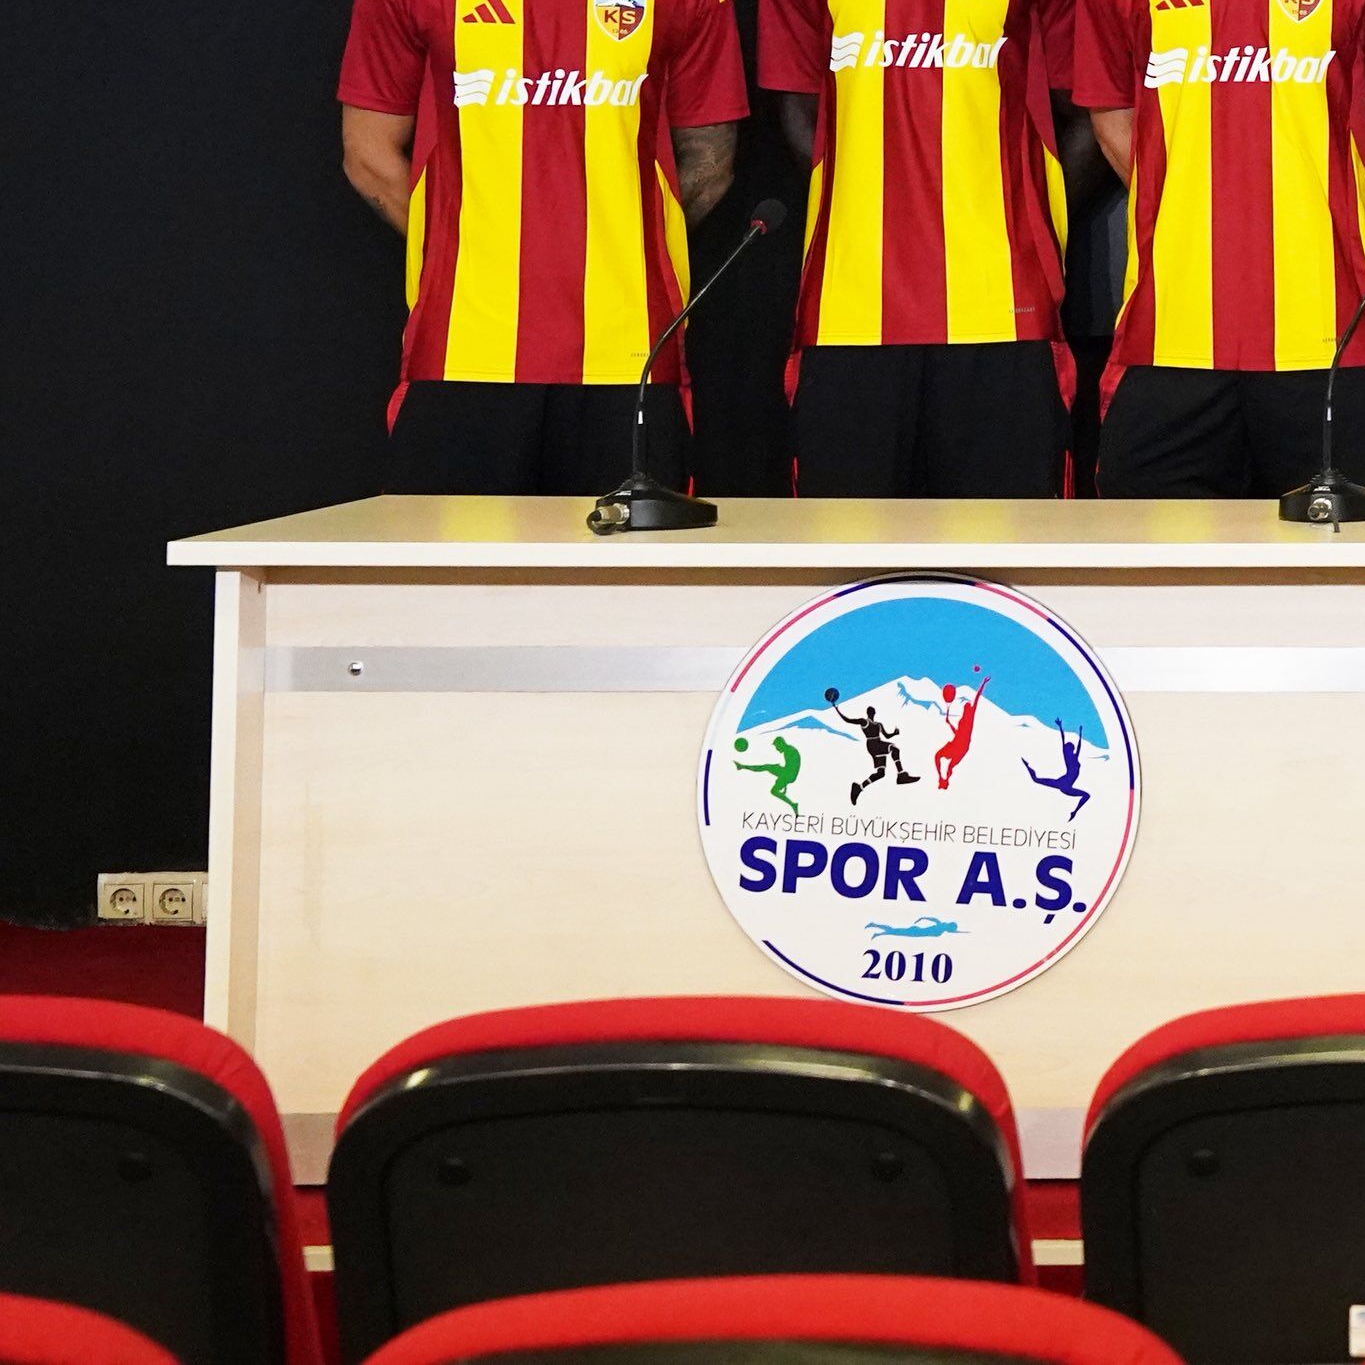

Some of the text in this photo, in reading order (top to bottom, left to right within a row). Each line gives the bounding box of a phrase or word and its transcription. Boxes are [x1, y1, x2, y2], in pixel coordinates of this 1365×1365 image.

[604, 9, 636, 24] KS
[863, 31, 1007, 68] istikbal
[1187, 46, 1336, 83] istikbal
[496, 69, 648, 106] istikbal
[742, 810, 1077, 851] KAYSERİ BÜYÜKŞEHİR BELEDİYESİ
[738, 835, 1088, 924] SPOR A.Ş.
[861, 949, 953, 984] 2010
